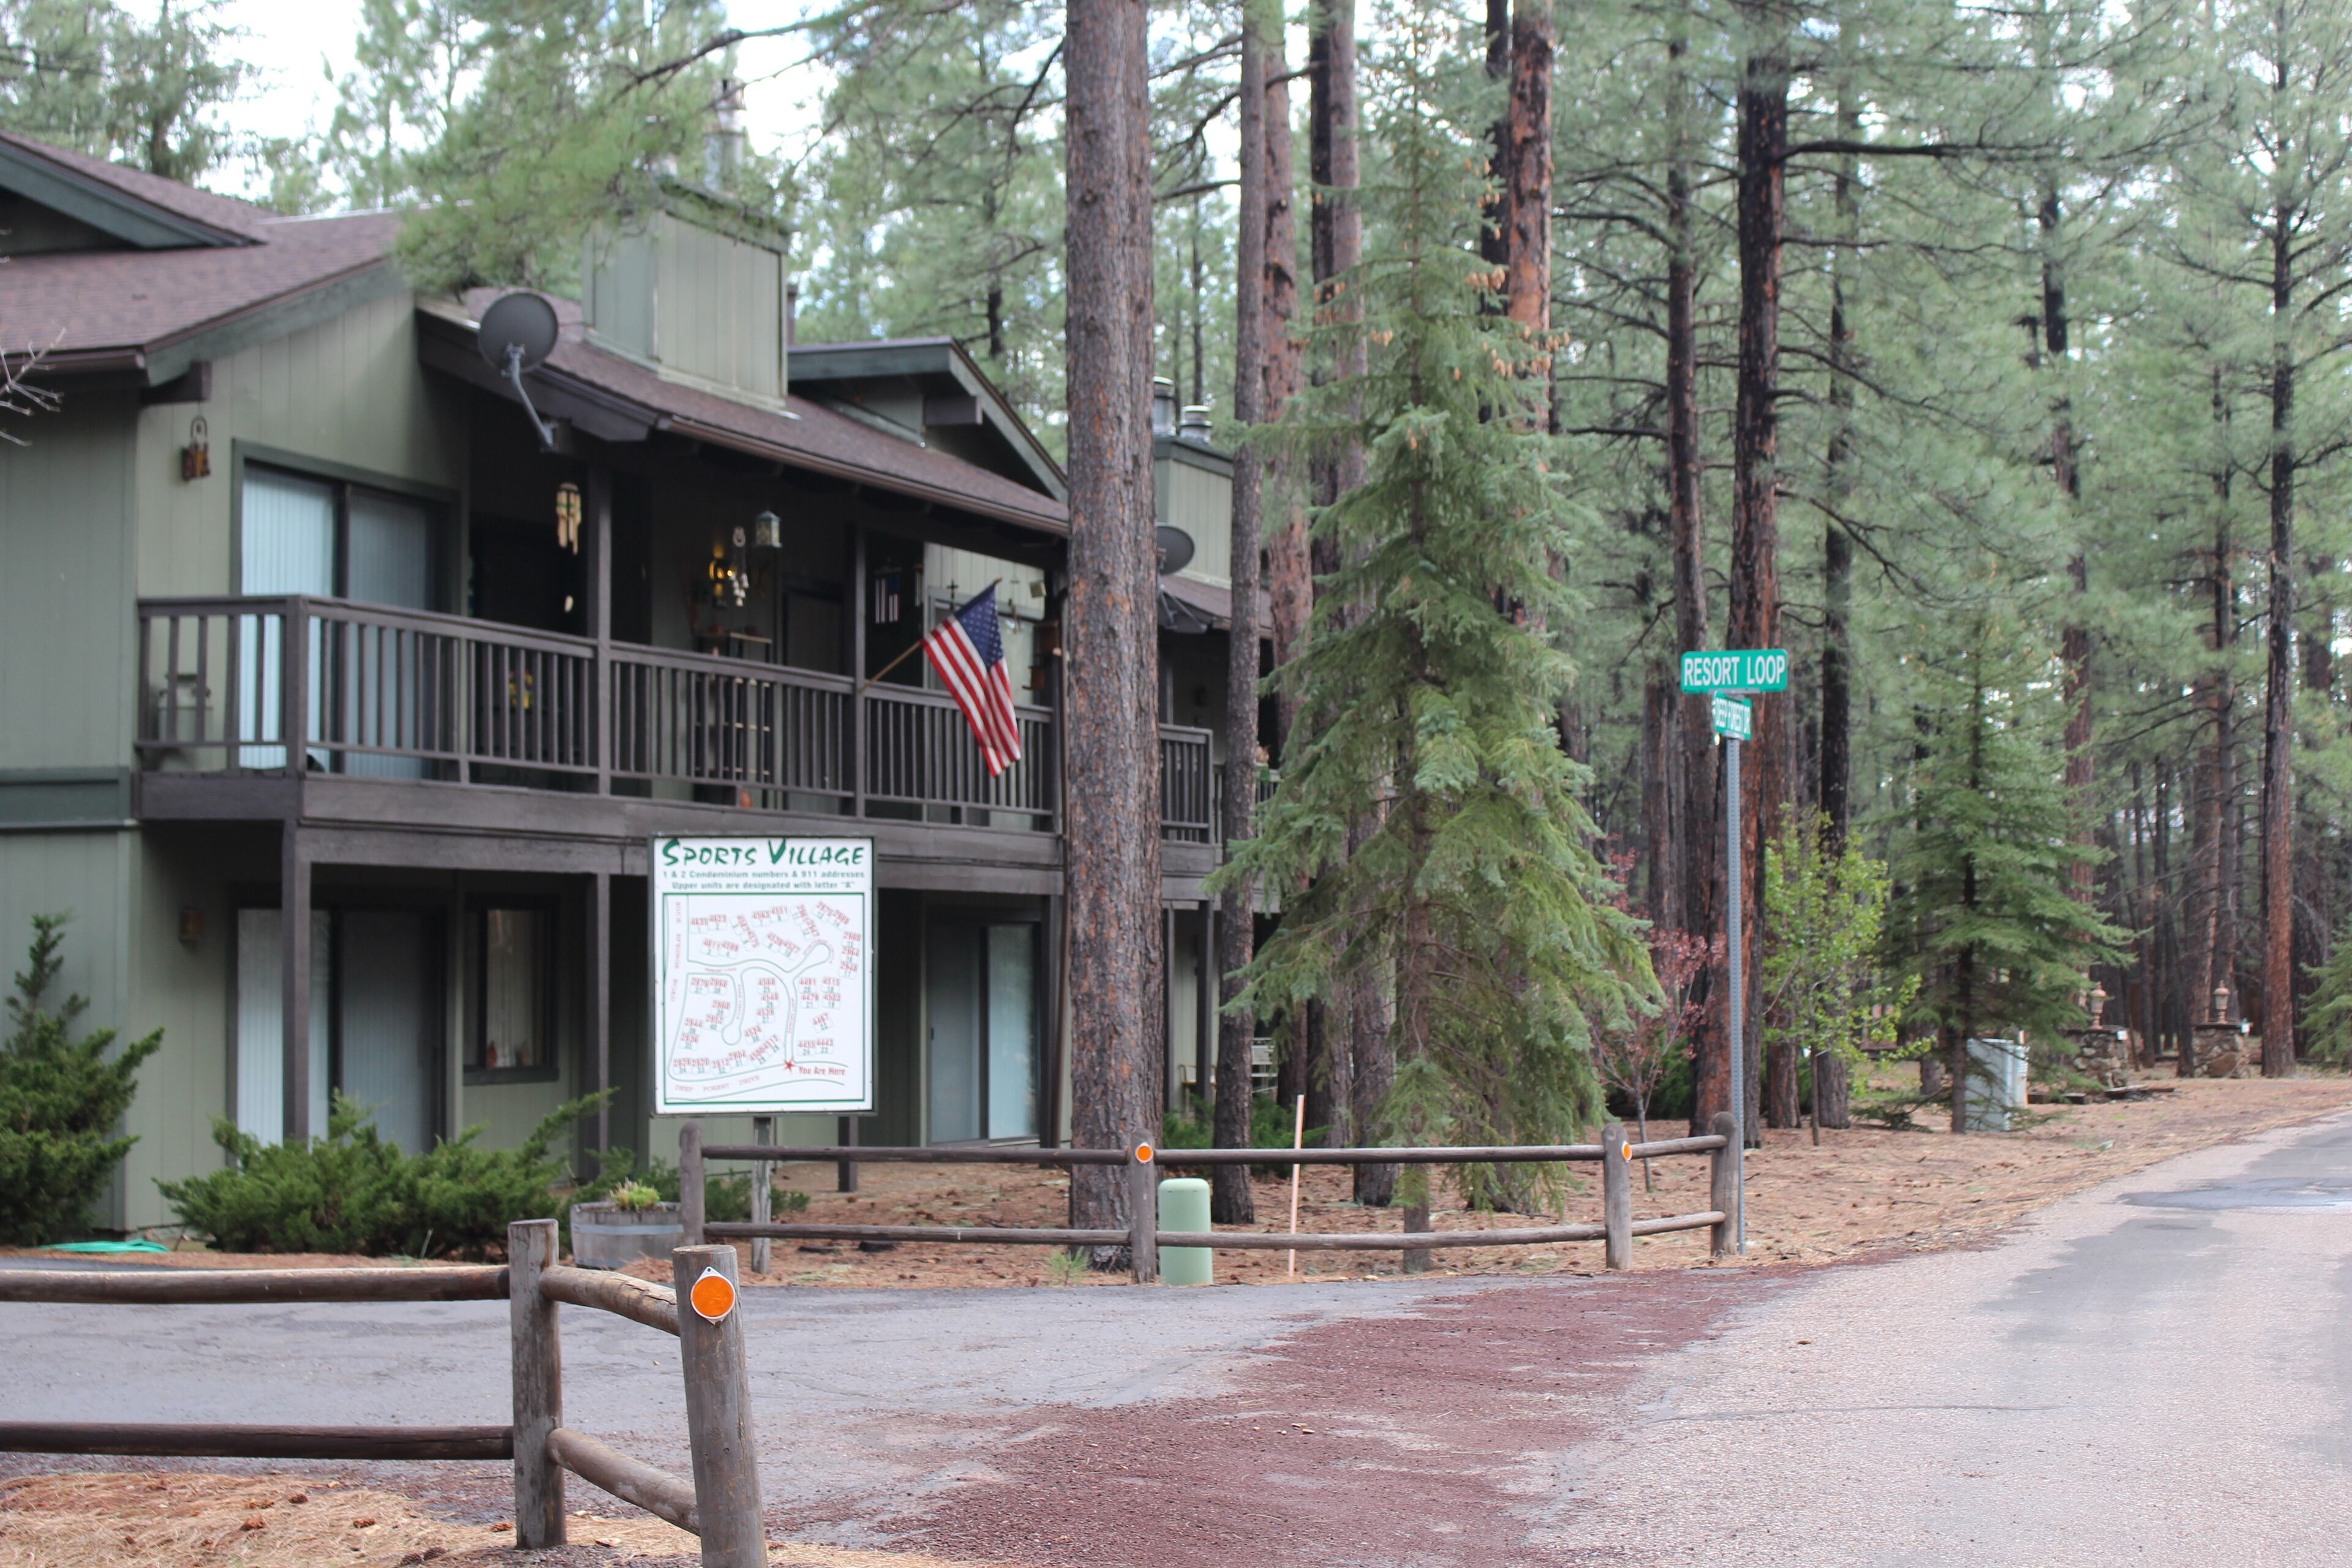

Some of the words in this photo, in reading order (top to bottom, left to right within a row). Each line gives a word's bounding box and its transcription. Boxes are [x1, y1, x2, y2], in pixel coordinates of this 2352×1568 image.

[1684, 656, 1741, 686] RESORT
[1747, 655, 1785, 685] LOOP
[662, 839, 757, 866] SPORTS
[768, 839, 865, 866] VILLAGE
[743, 882, 790, 891] designated
[828, 1067, 848, 1076] Here
